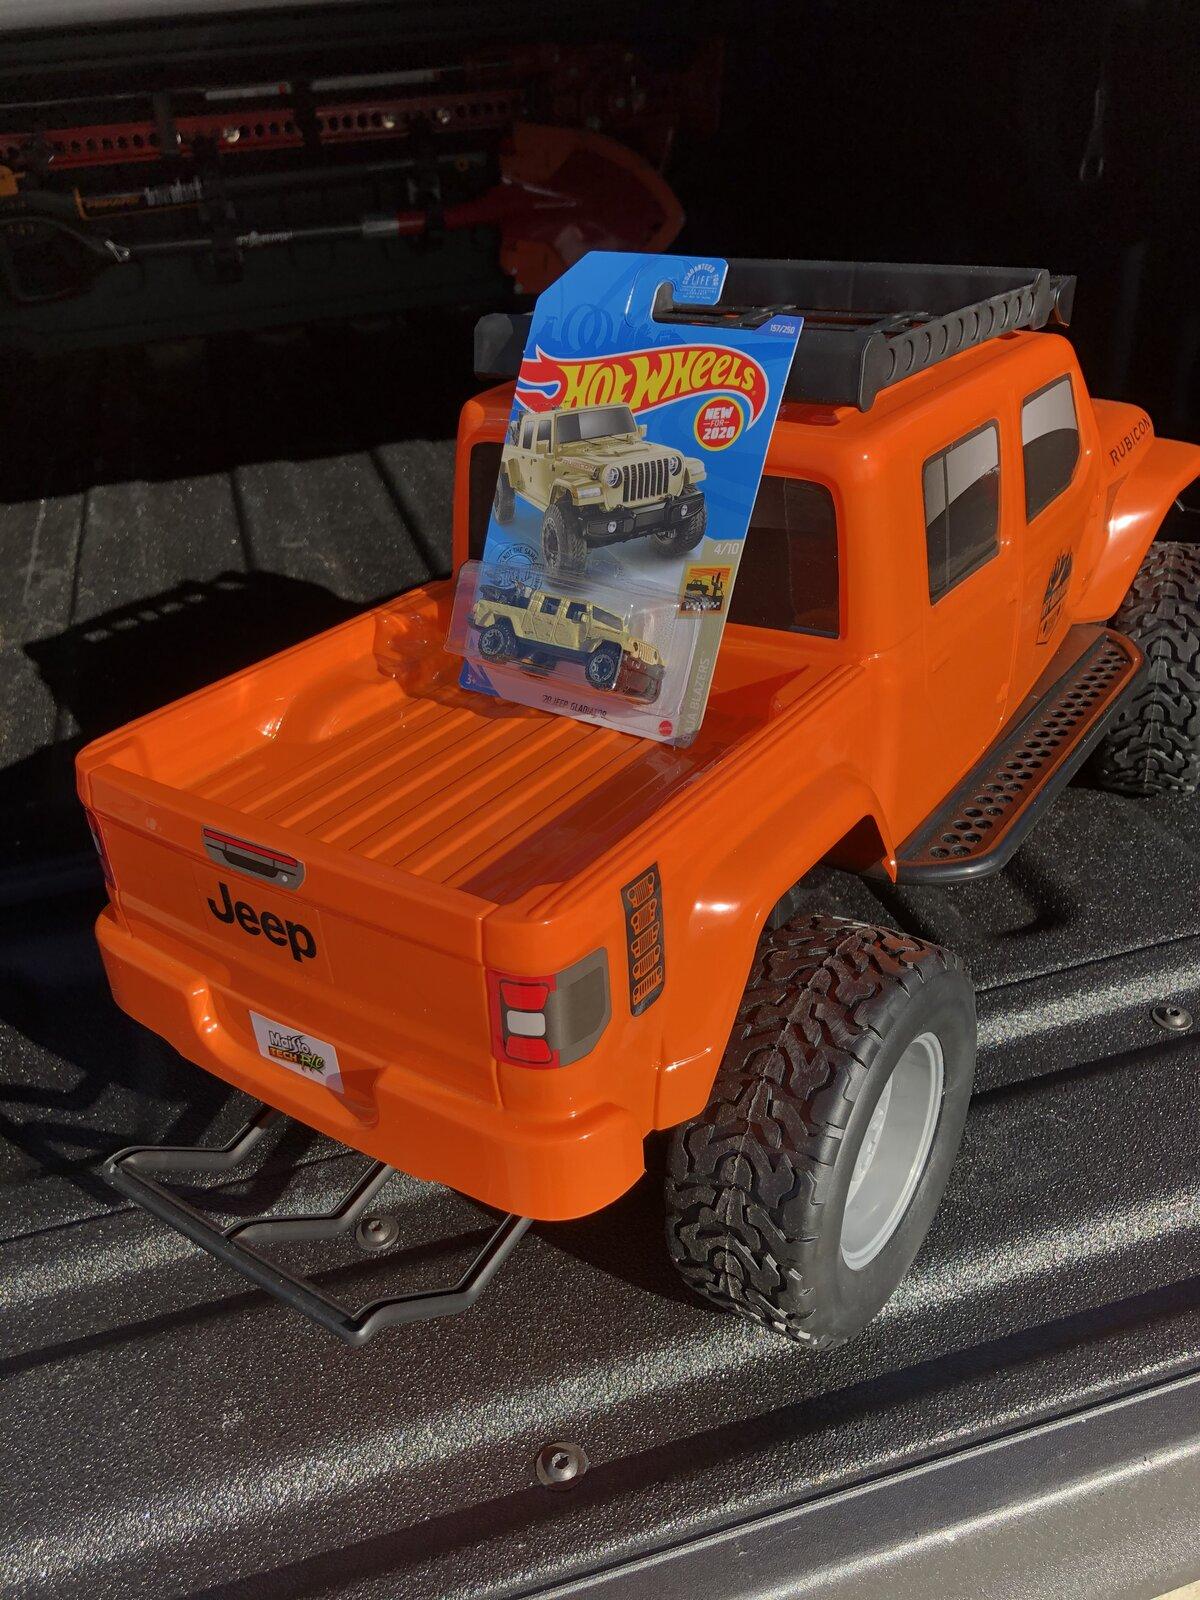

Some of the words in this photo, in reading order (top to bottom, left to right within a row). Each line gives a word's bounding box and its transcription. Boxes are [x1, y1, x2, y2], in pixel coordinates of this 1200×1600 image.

[691, 274, 710, 286] LIFE
[770, 324, 795, 335] 157/250
[704, 406, 735, 420] NEW
[710, 419, 725, 427] FOR
[702, 426, 735, 440] 2020
[1109, 416, 1150, 467] RUBICON
[714, 542, 740, 555] 4/10
[690, 658, 710, 709] BLAZERS
[207, 881, 317, 963] Jeep
[268, 1030, 312, 1055] Maisto
[269, 1047, 299, 1063] TECH
